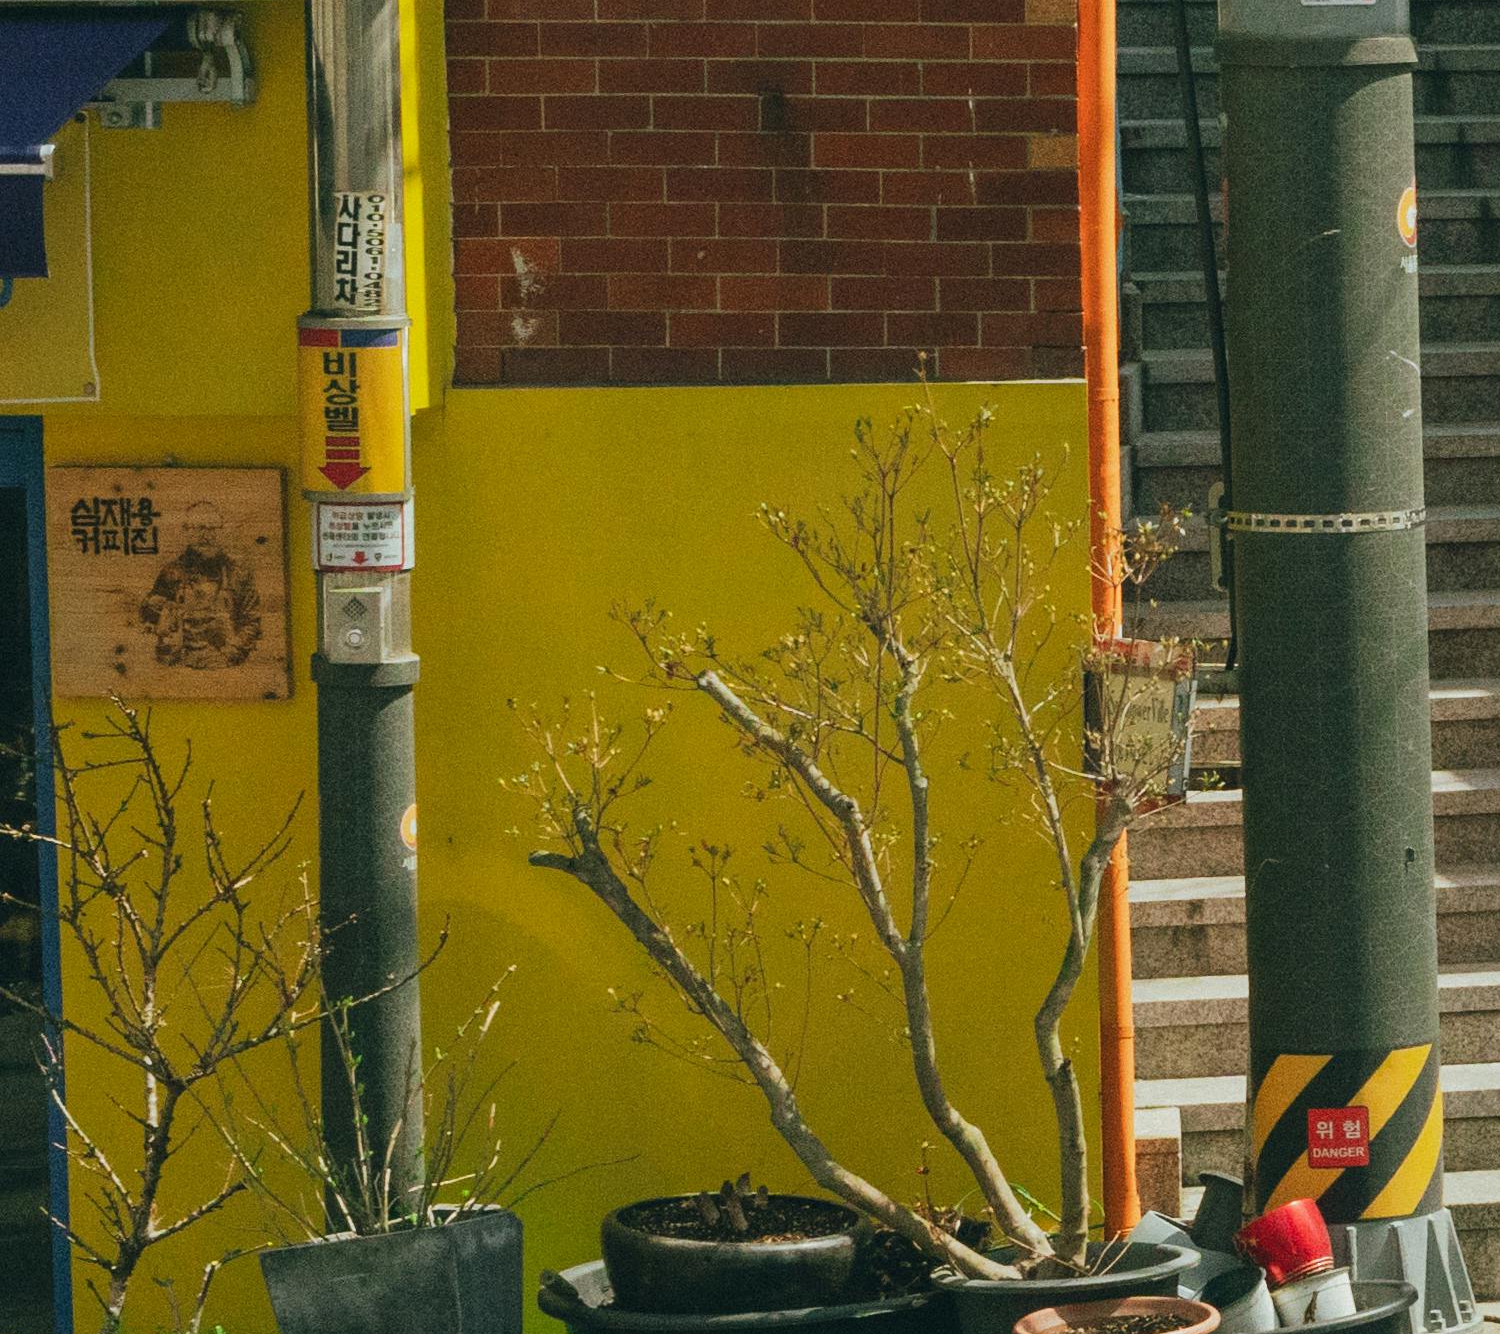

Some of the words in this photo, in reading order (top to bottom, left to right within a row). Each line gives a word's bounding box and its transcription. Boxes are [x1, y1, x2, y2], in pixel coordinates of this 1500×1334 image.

[335, 195, 362, 306] 사다리차
[322, 351, 359, 433] 비상벨
[71, 526, 159, 555] 커피집
[1313, 1145, 1364, 1159] DANGER
